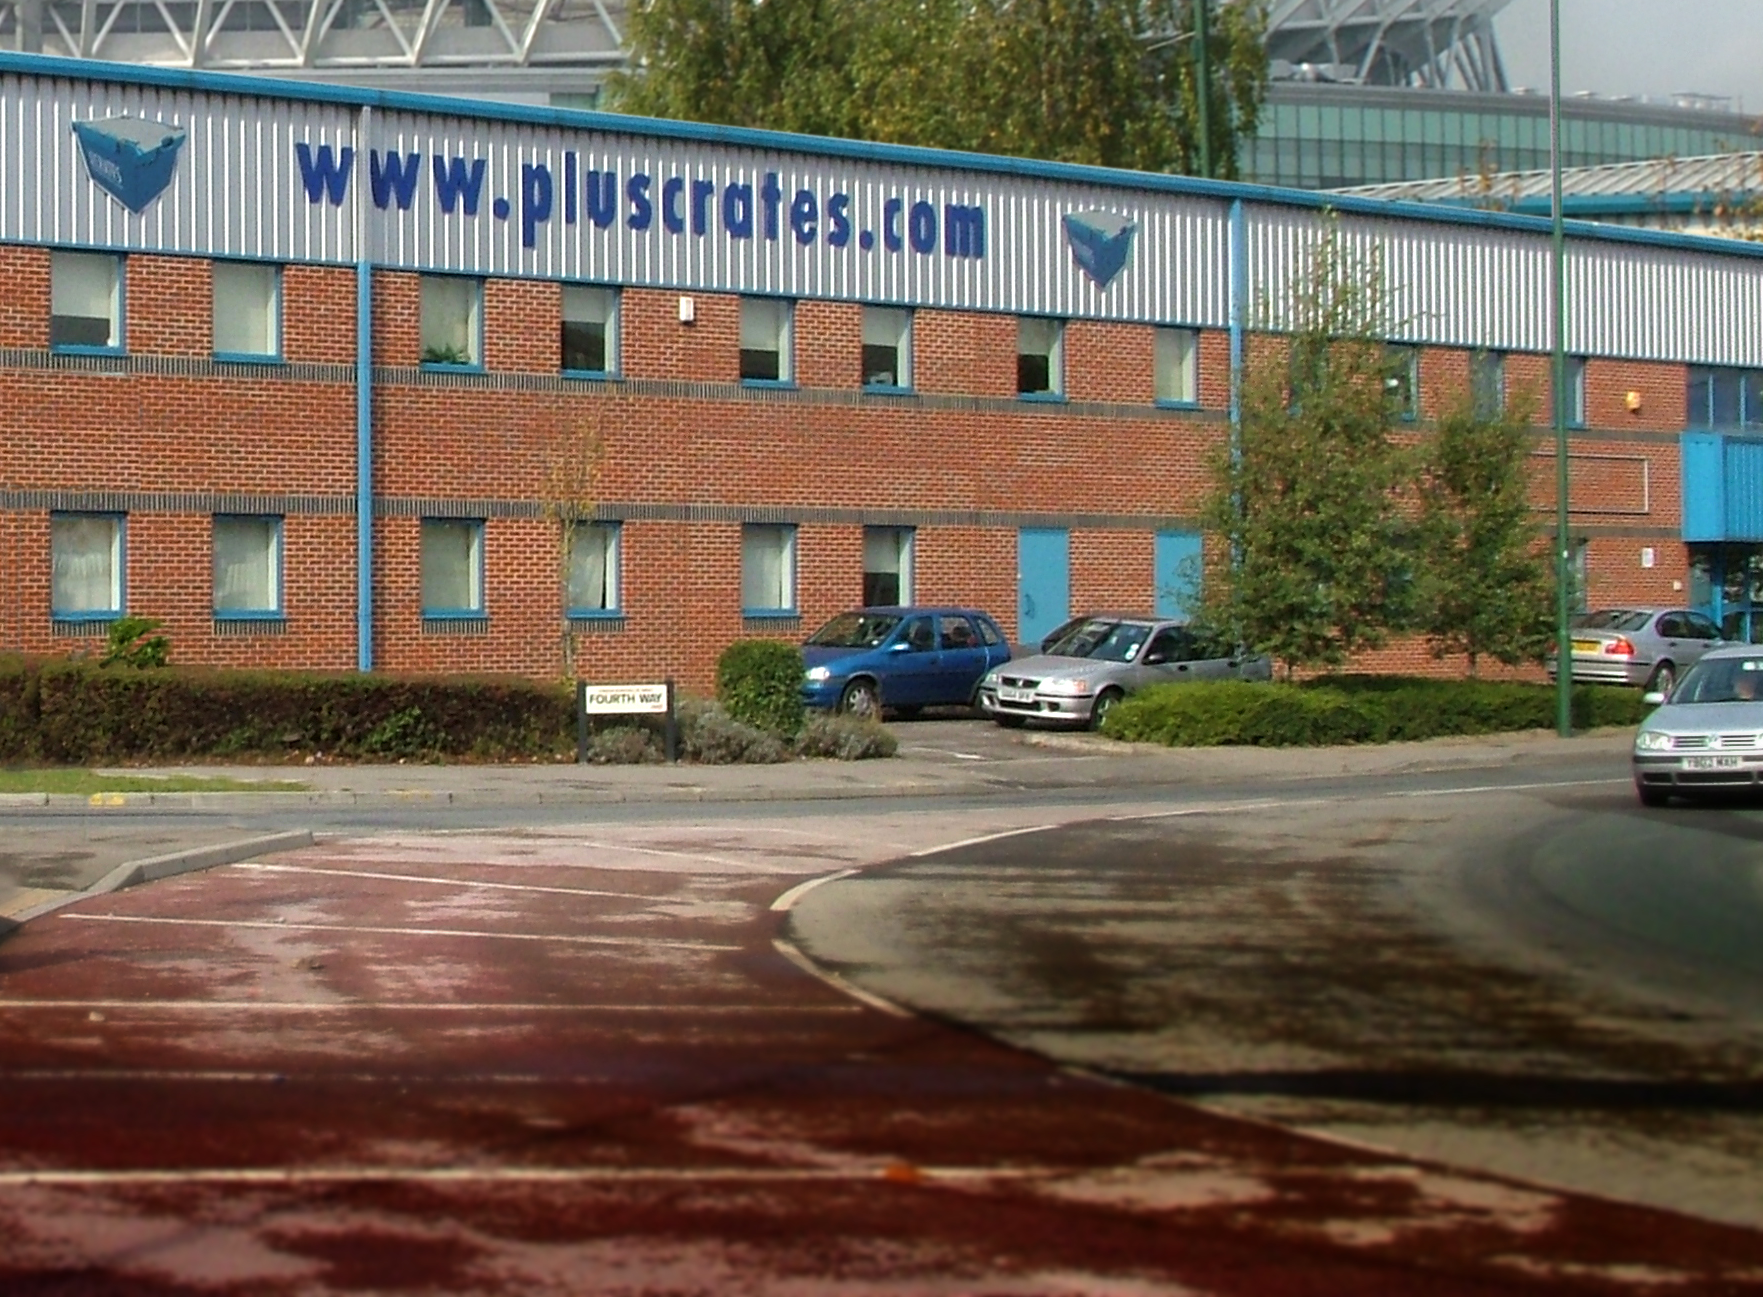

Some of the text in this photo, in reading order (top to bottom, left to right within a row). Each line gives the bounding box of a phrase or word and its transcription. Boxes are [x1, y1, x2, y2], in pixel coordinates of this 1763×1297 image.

[296, 142, 984, 260] www.pluscrates.com
[589, 693, 663, 704] FOURTH WAY
